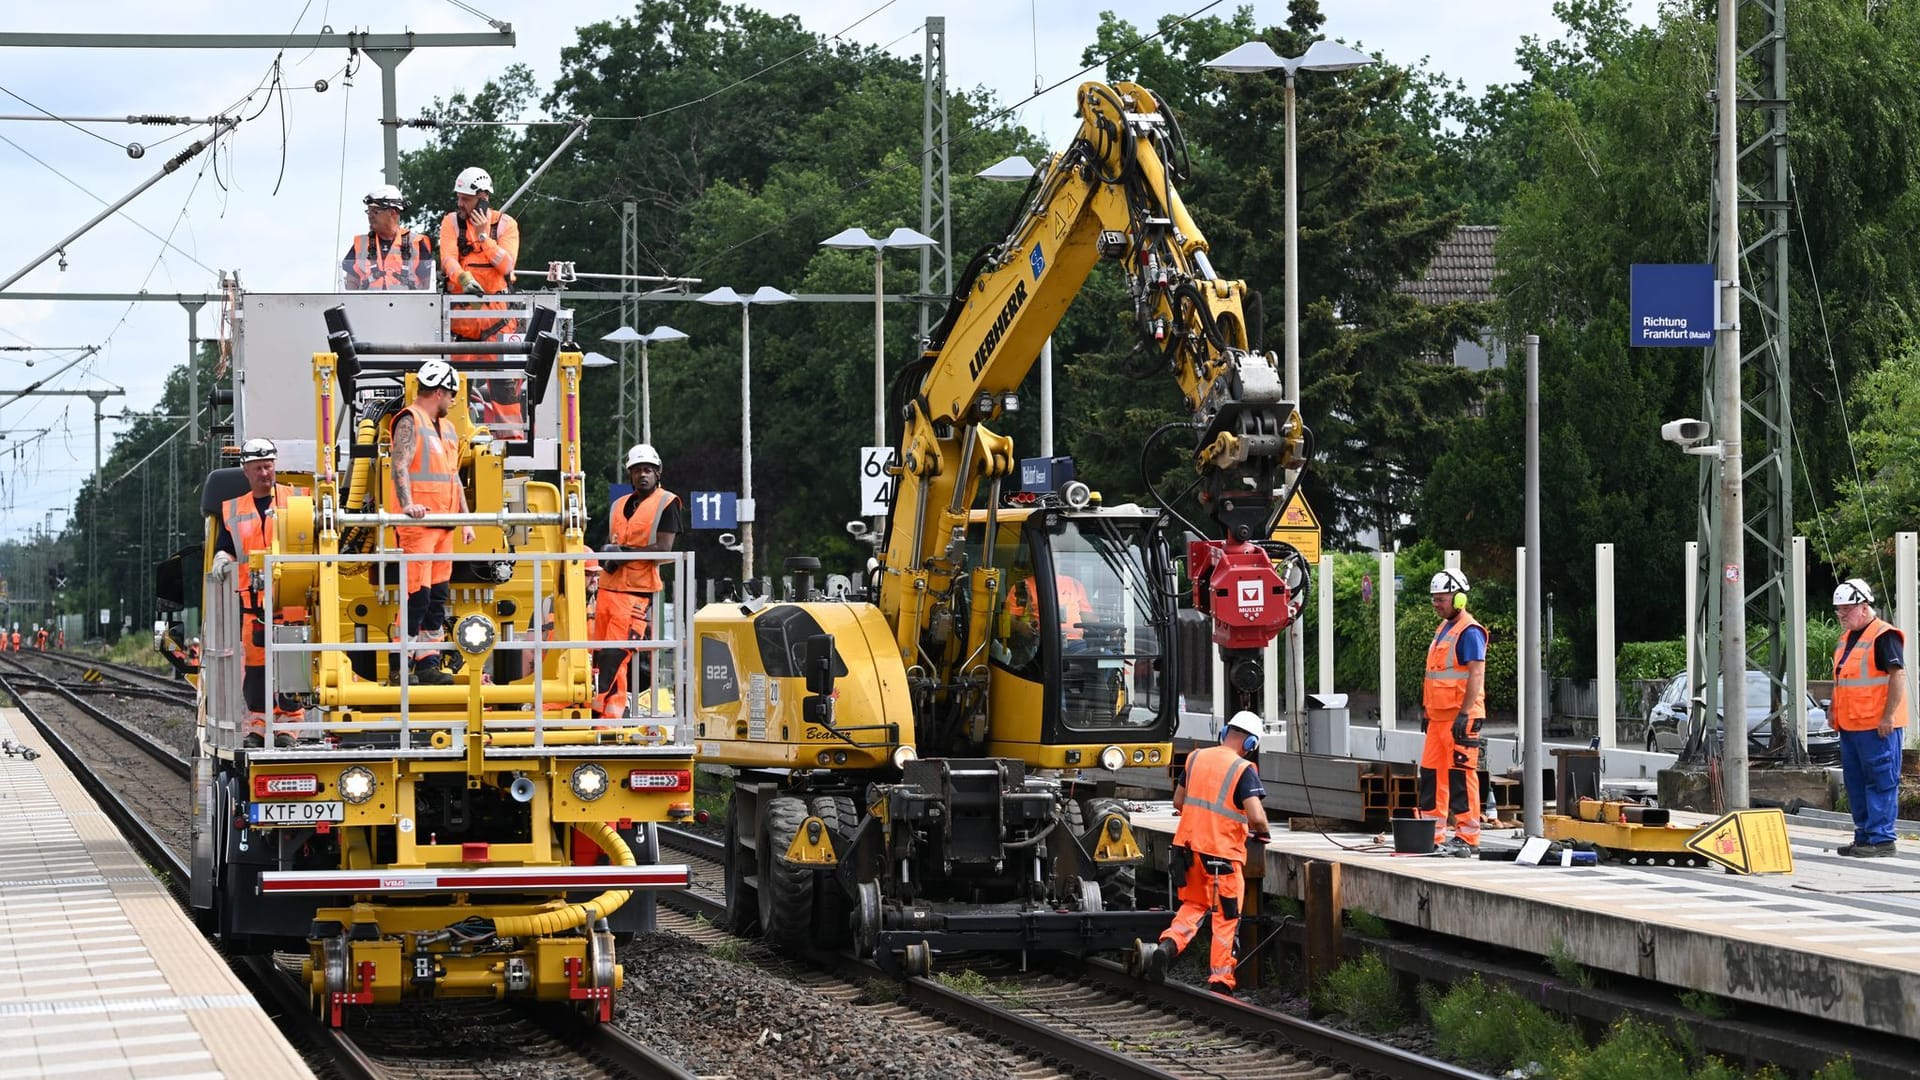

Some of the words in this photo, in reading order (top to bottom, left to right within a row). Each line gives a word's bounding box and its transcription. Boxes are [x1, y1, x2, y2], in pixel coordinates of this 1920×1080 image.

[968, 279, 1028, 382] LIEBHERR
[1643, 317, 1687, 329] Richtung
[1643, 329, 1688, 339] Frankfurt
[1689, 331, 1711, 339] (Main)
[873, 481, 889, 508] 4
[696, 493, 721, 521] 11
[706, 665, 728, 680] 922
[264, 804, 297, 820] KTF
[303, 803, 336, 819] 09Y
